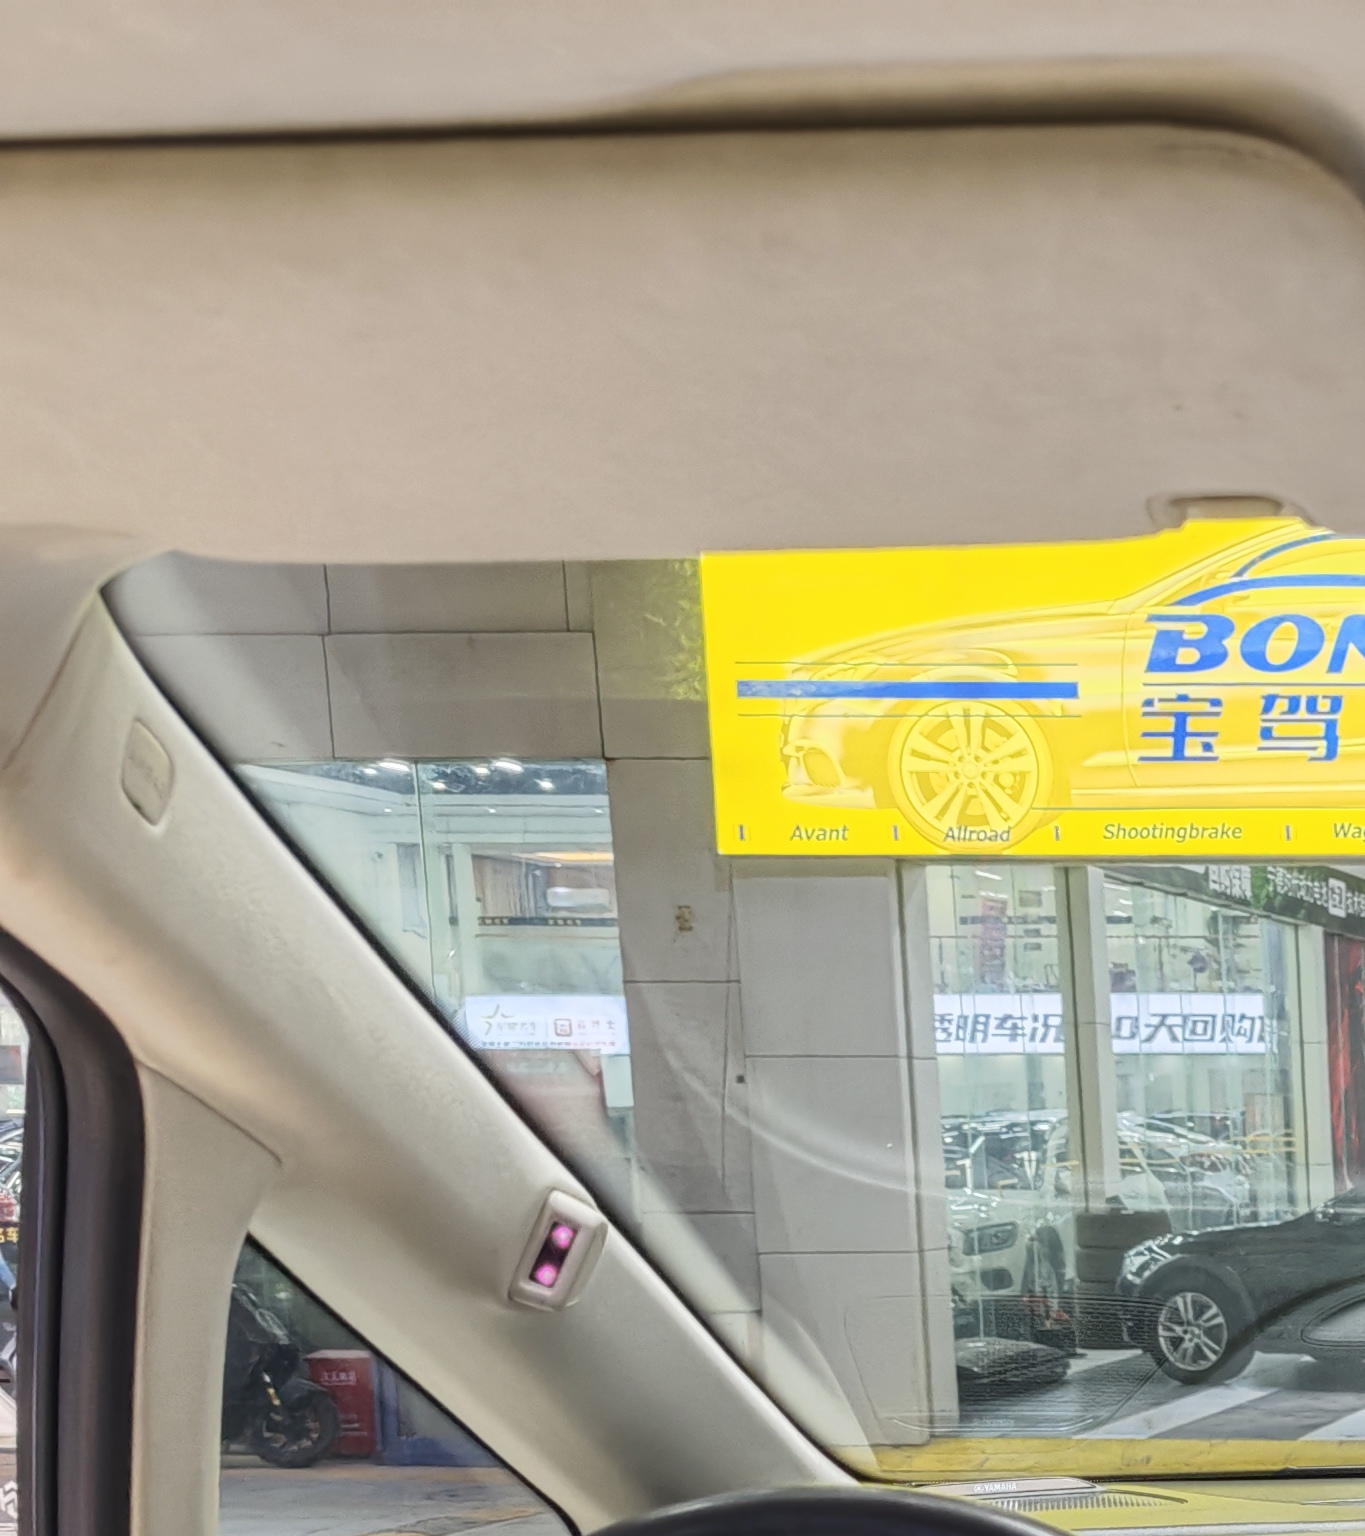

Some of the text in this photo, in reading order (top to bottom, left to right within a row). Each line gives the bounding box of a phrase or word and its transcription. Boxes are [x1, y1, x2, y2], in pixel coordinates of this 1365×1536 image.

[790, 822, 850, 842] Avant
[943, 824, 1012, 844] Allroad
[1102, 822, 1243, 841] Shootingbrake
